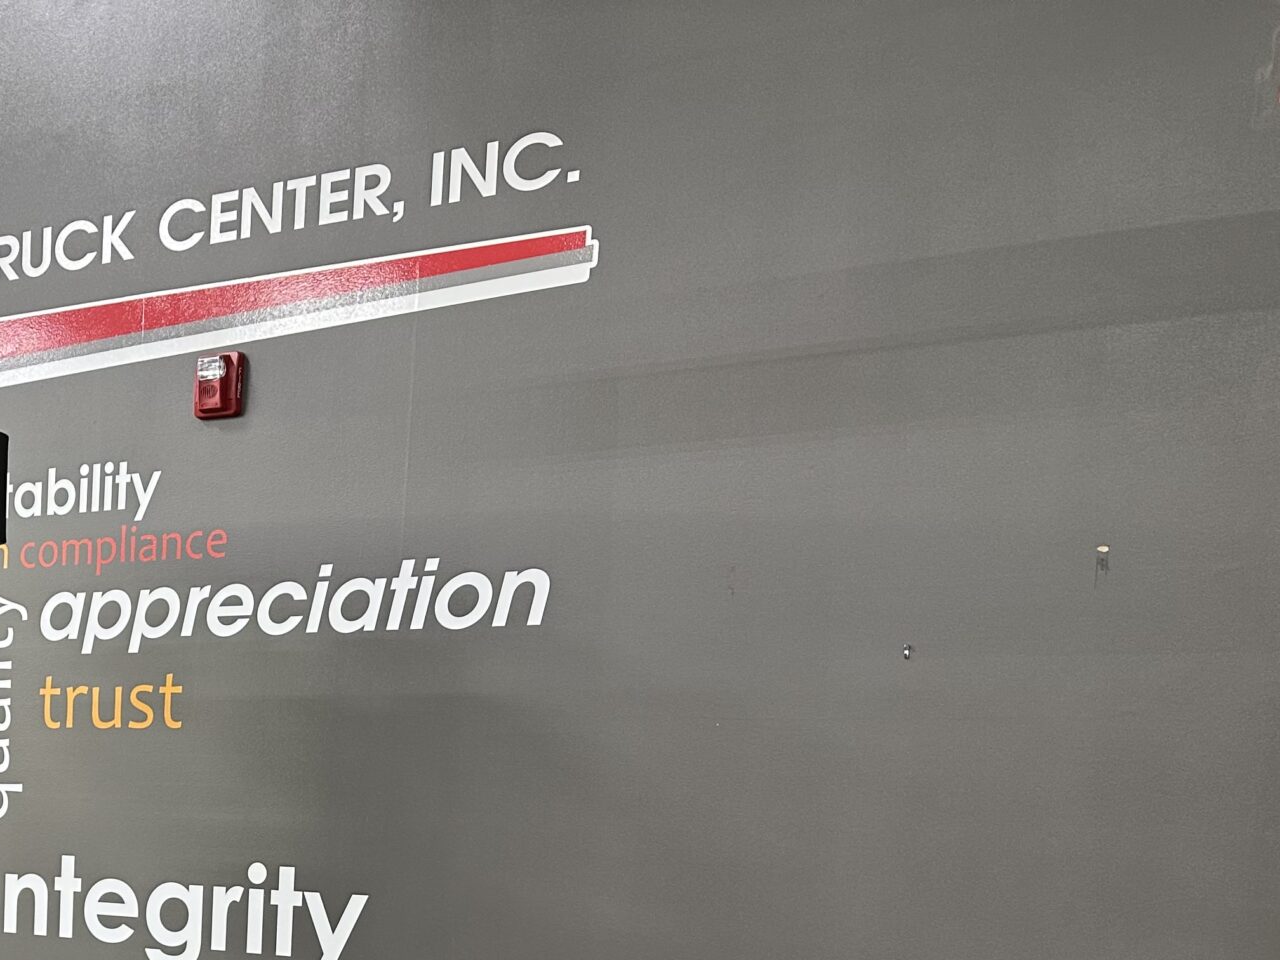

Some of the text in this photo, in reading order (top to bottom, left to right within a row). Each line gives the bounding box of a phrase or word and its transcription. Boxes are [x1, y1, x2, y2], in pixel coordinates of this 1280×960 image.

[158, 163, 406, 252] CENTER,
[429, 131, 580, 207] INC.
[20, 526, 228, 576] compliance
[39, 557, 552, 655] appreciation
[39, 673, 184, 730] trust
